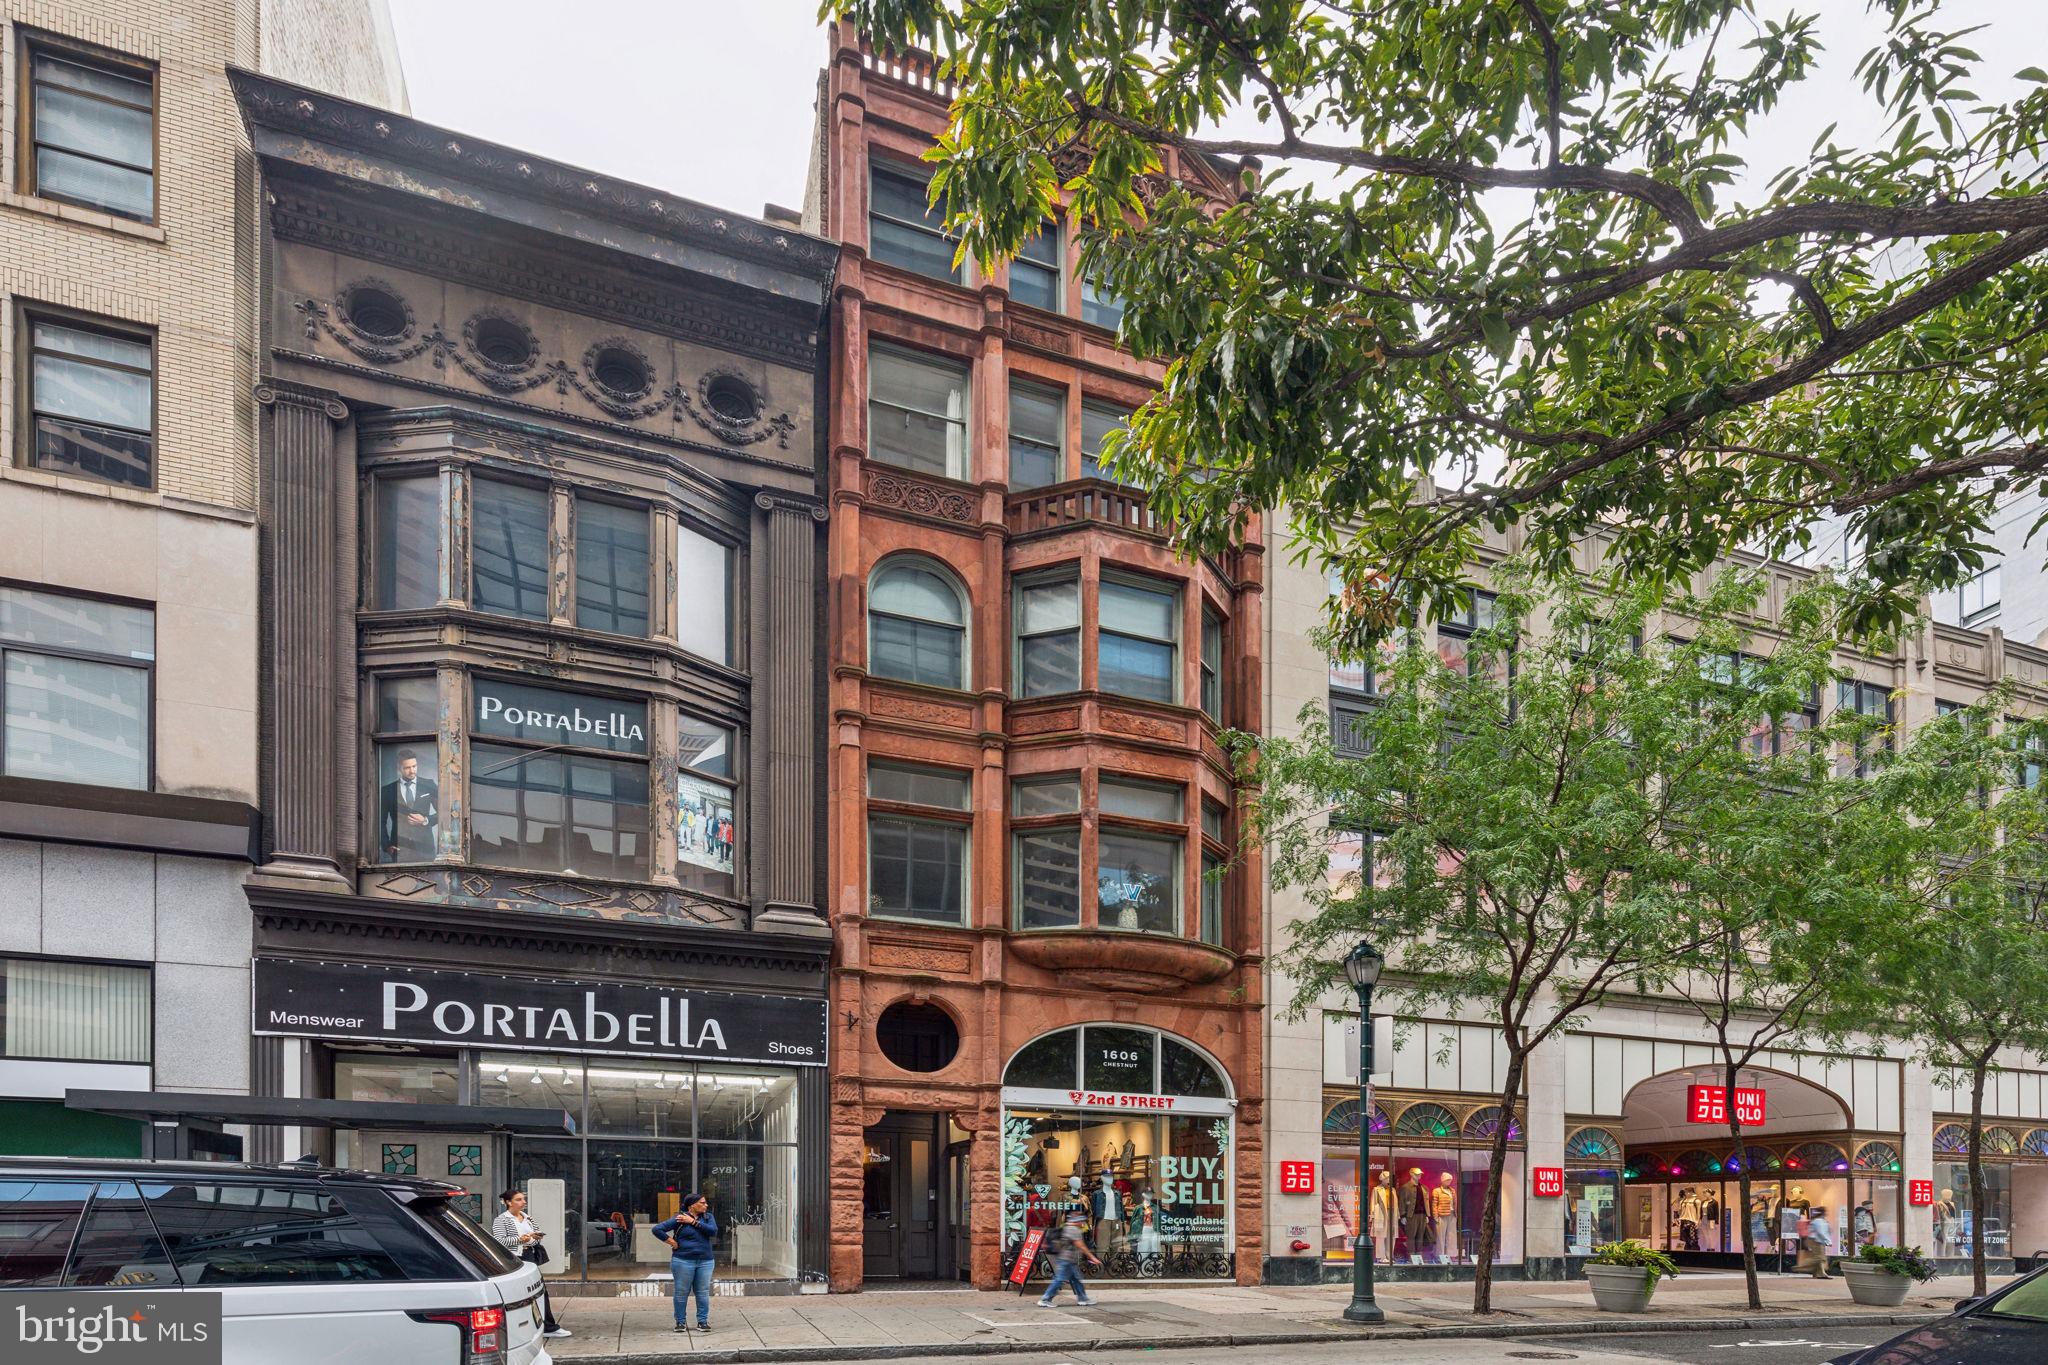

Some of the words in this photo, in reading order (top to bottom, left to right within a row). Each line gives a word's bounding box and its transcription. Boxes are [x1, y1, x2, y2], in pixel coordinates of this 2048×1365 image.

[270, 1010, 364, 1028] Menswear
[768, 1041, 814, 1056] Shoes
[1102, 1049, 1138, 1061] 1606
[1087, 1093, 1115, 1105] 2nd
[1120, 1095, 1175, 1110] STREET
[1737, 1092, 1760, 1106] UNI
[1736, 1107, 1762, 1122] QLO
[1160, 1155, 1219, 1180] BUY
[1539, 1171, 1558, 1181] UNI
[1161, 1181, 1226, 1205] SELL
[1539, 1182, 1560, 1193] QLO
[1008, 1201, 1031, 1210] 2nd
[1034, 1201, 1078, 1211] STREET
[1160, 1215, 1228, 1225] Secondhand
